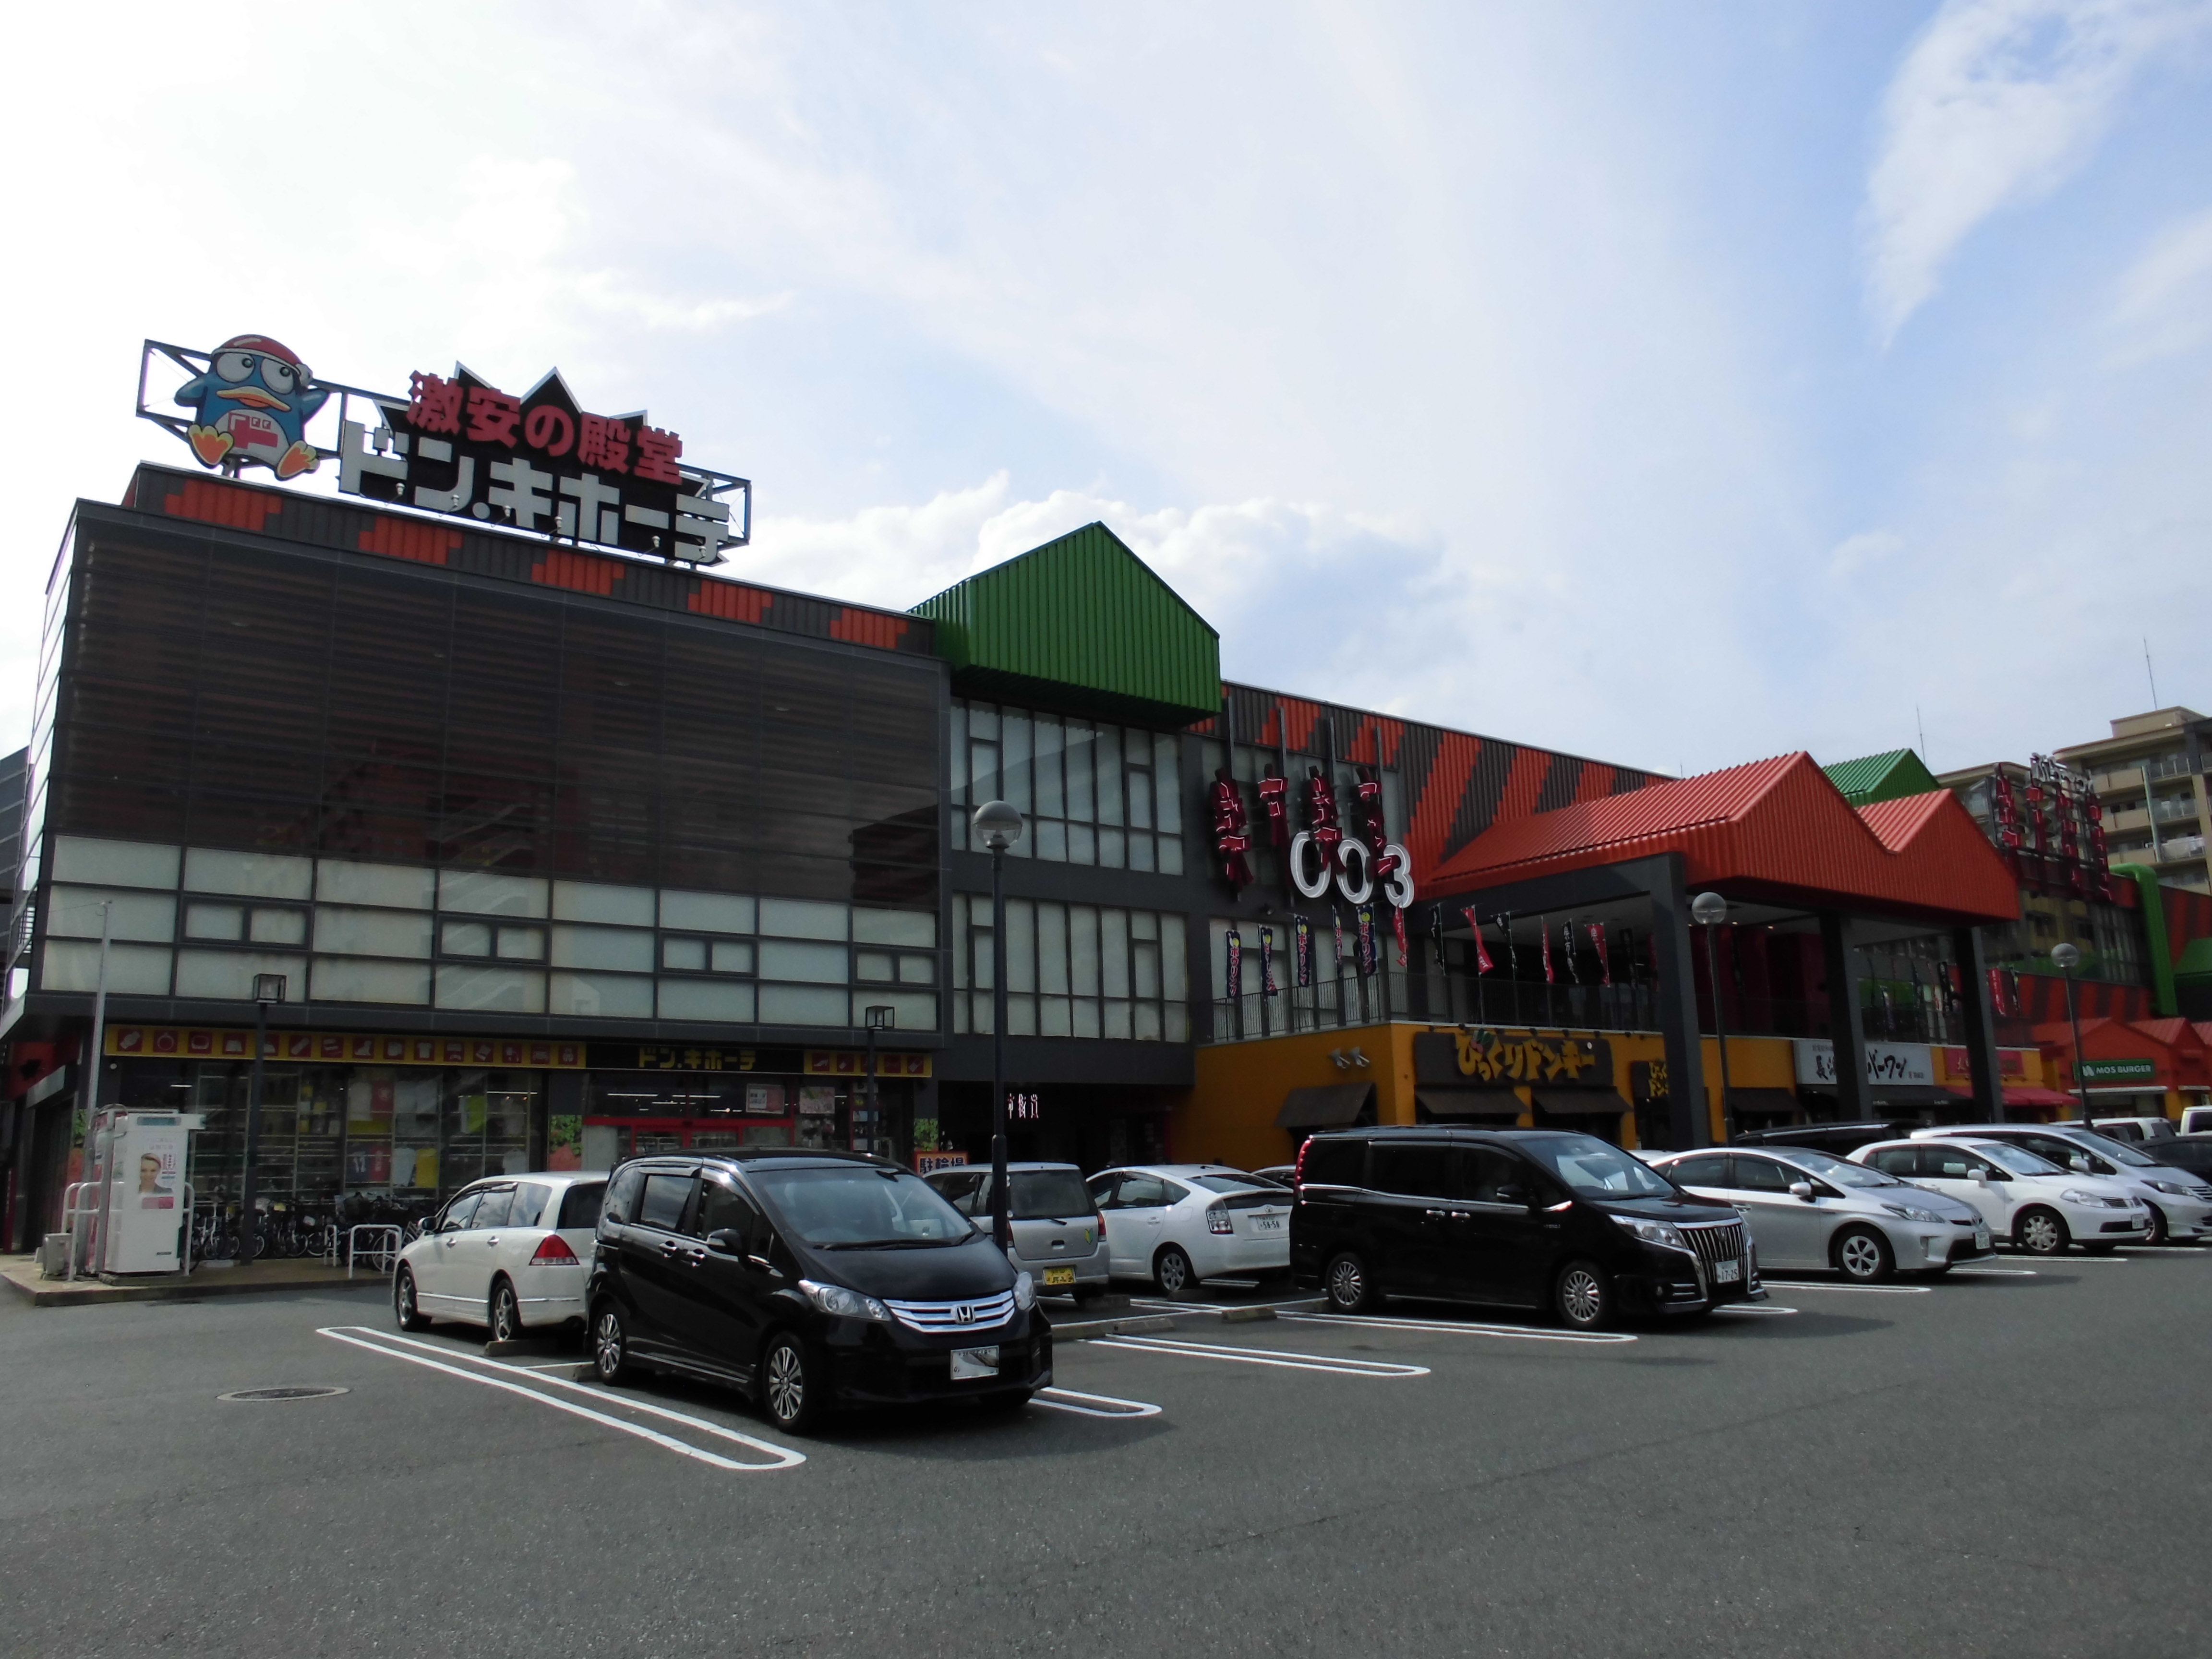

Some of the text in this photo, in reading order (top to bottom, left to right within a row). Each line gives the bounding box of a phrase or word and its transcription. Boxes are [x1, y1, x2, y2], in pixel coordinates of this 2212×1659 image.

[406, 370, 683, 485] 激安の殿堂
[1229, 947, 1239, 997] ボウリング
[1297, 934, 1308, 986] ボウリング
[1358, 922, 1372, 974] ボウリング
[1455, 1033, 1595, 1082] びっくりドンキー
[1648, 1061, 1668, 1080] びっく
[2096, 1064, 2152, 1074] MOS BURGER
